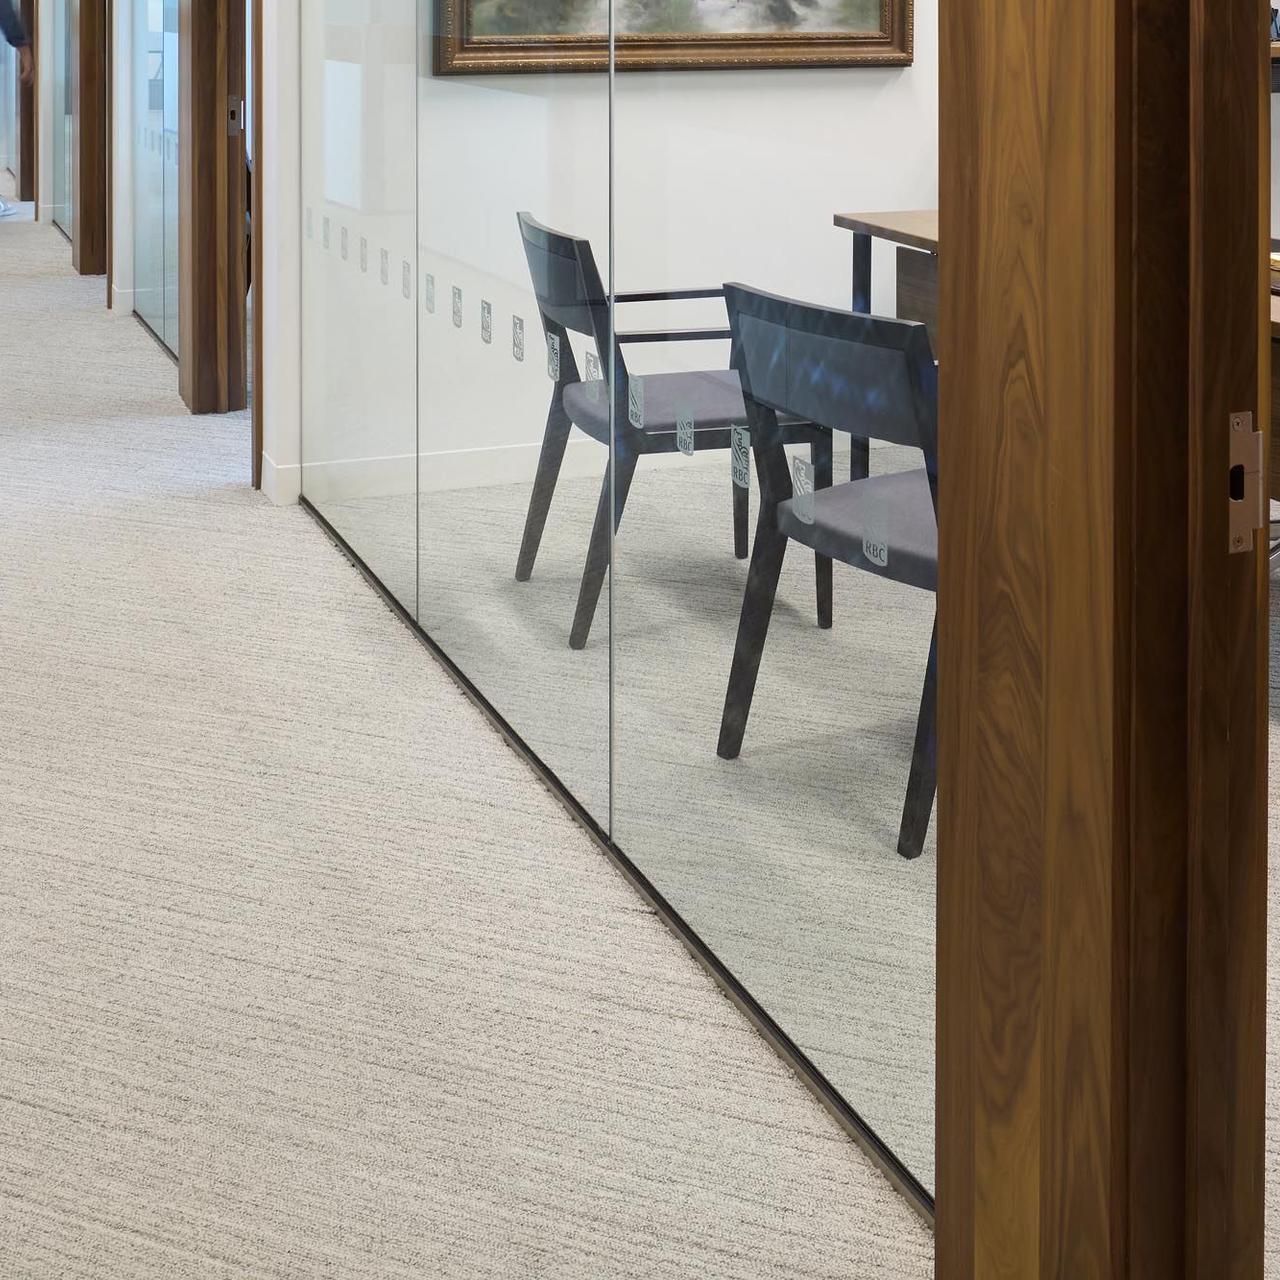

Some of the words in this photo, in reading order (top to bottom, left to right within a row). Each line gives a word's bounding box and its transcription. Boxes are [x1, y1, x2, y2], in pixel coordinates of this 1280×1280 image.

[678, 437, 692, 452] RBC
[733, 467, 749, 485] RBC
[865, 540, 886, 562] RBC
